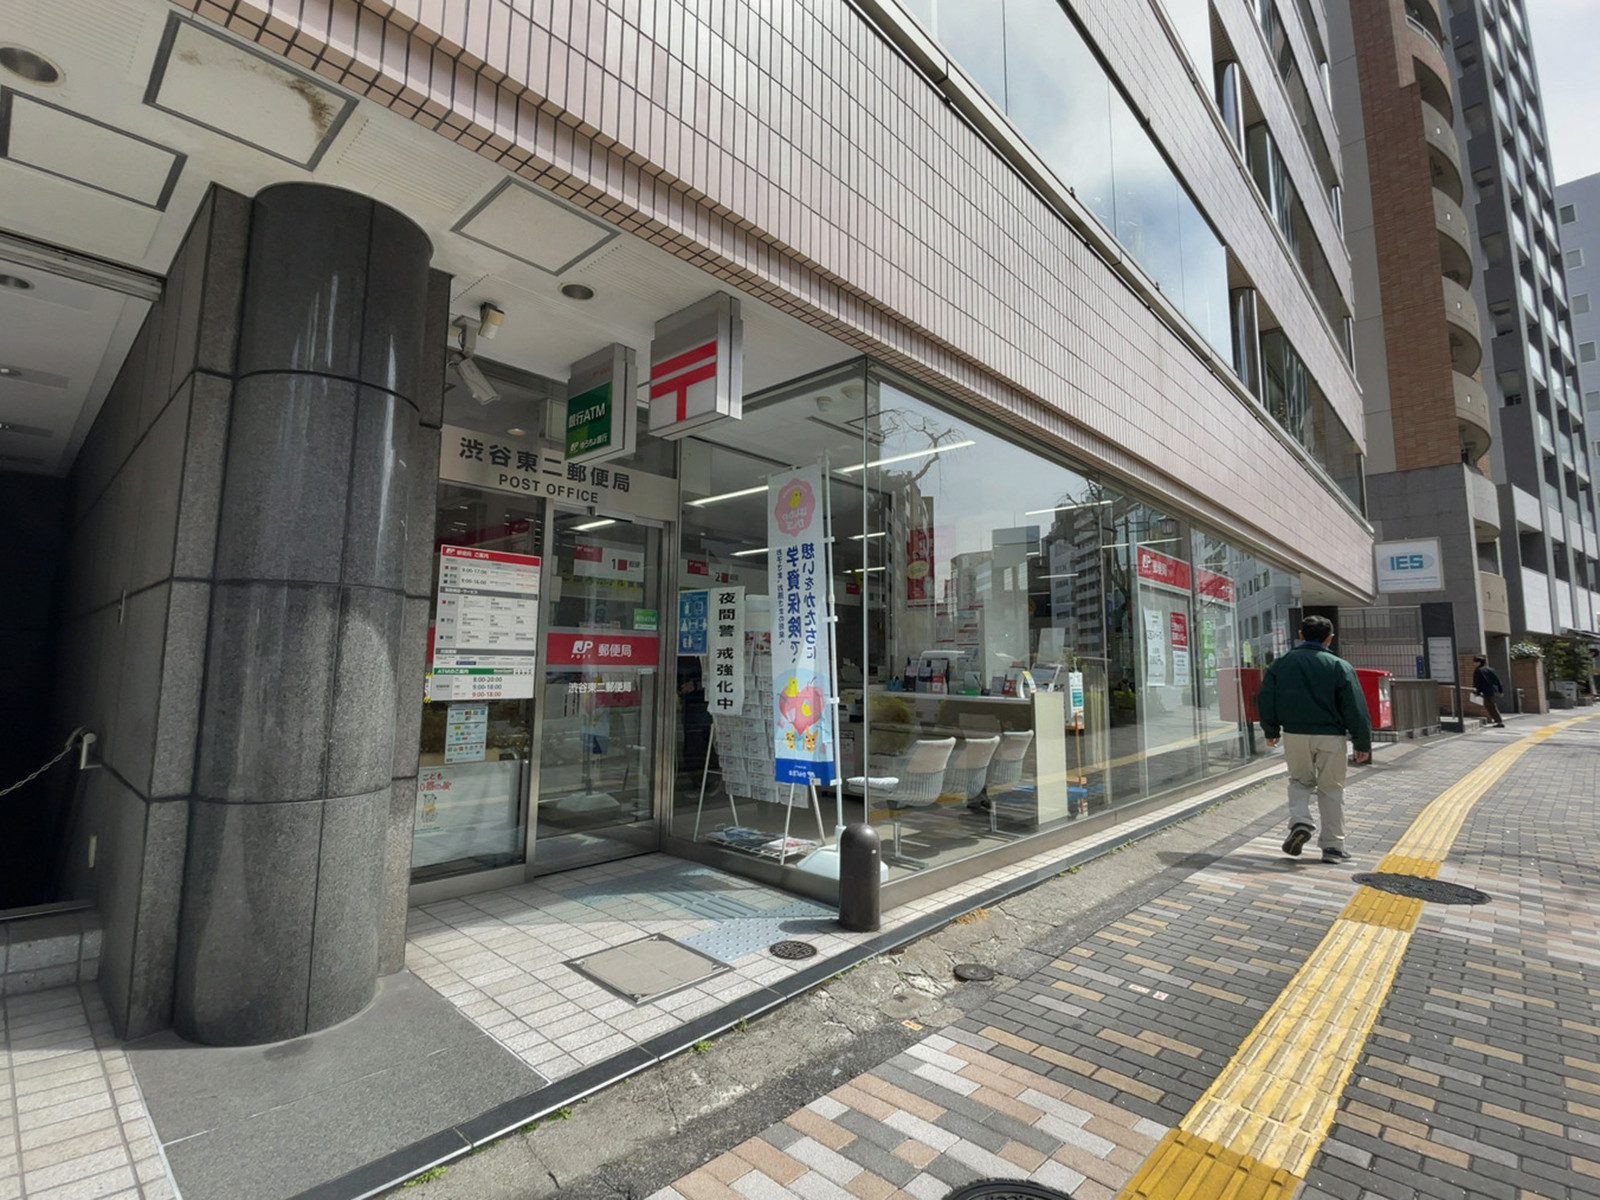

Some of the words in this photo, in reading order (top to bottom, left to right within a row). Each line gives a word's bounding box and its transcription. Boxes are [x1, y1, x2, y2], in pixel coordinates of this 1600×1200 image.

[568, 402, 606, 429] 銀行ATM
[458, 436, 631, 493] 渋谷東二郵便局
[499, 473, 540, 492] POST
[546, 483, 599, 503] OFFICE
[1390, 554, 1424, 570] IES
[598, 643, 632, 658] 郵便局
[717, 592, 736, 710] 夜間警戒強化中
[568, 681, 632, 694] 渋谷東二郵便局
